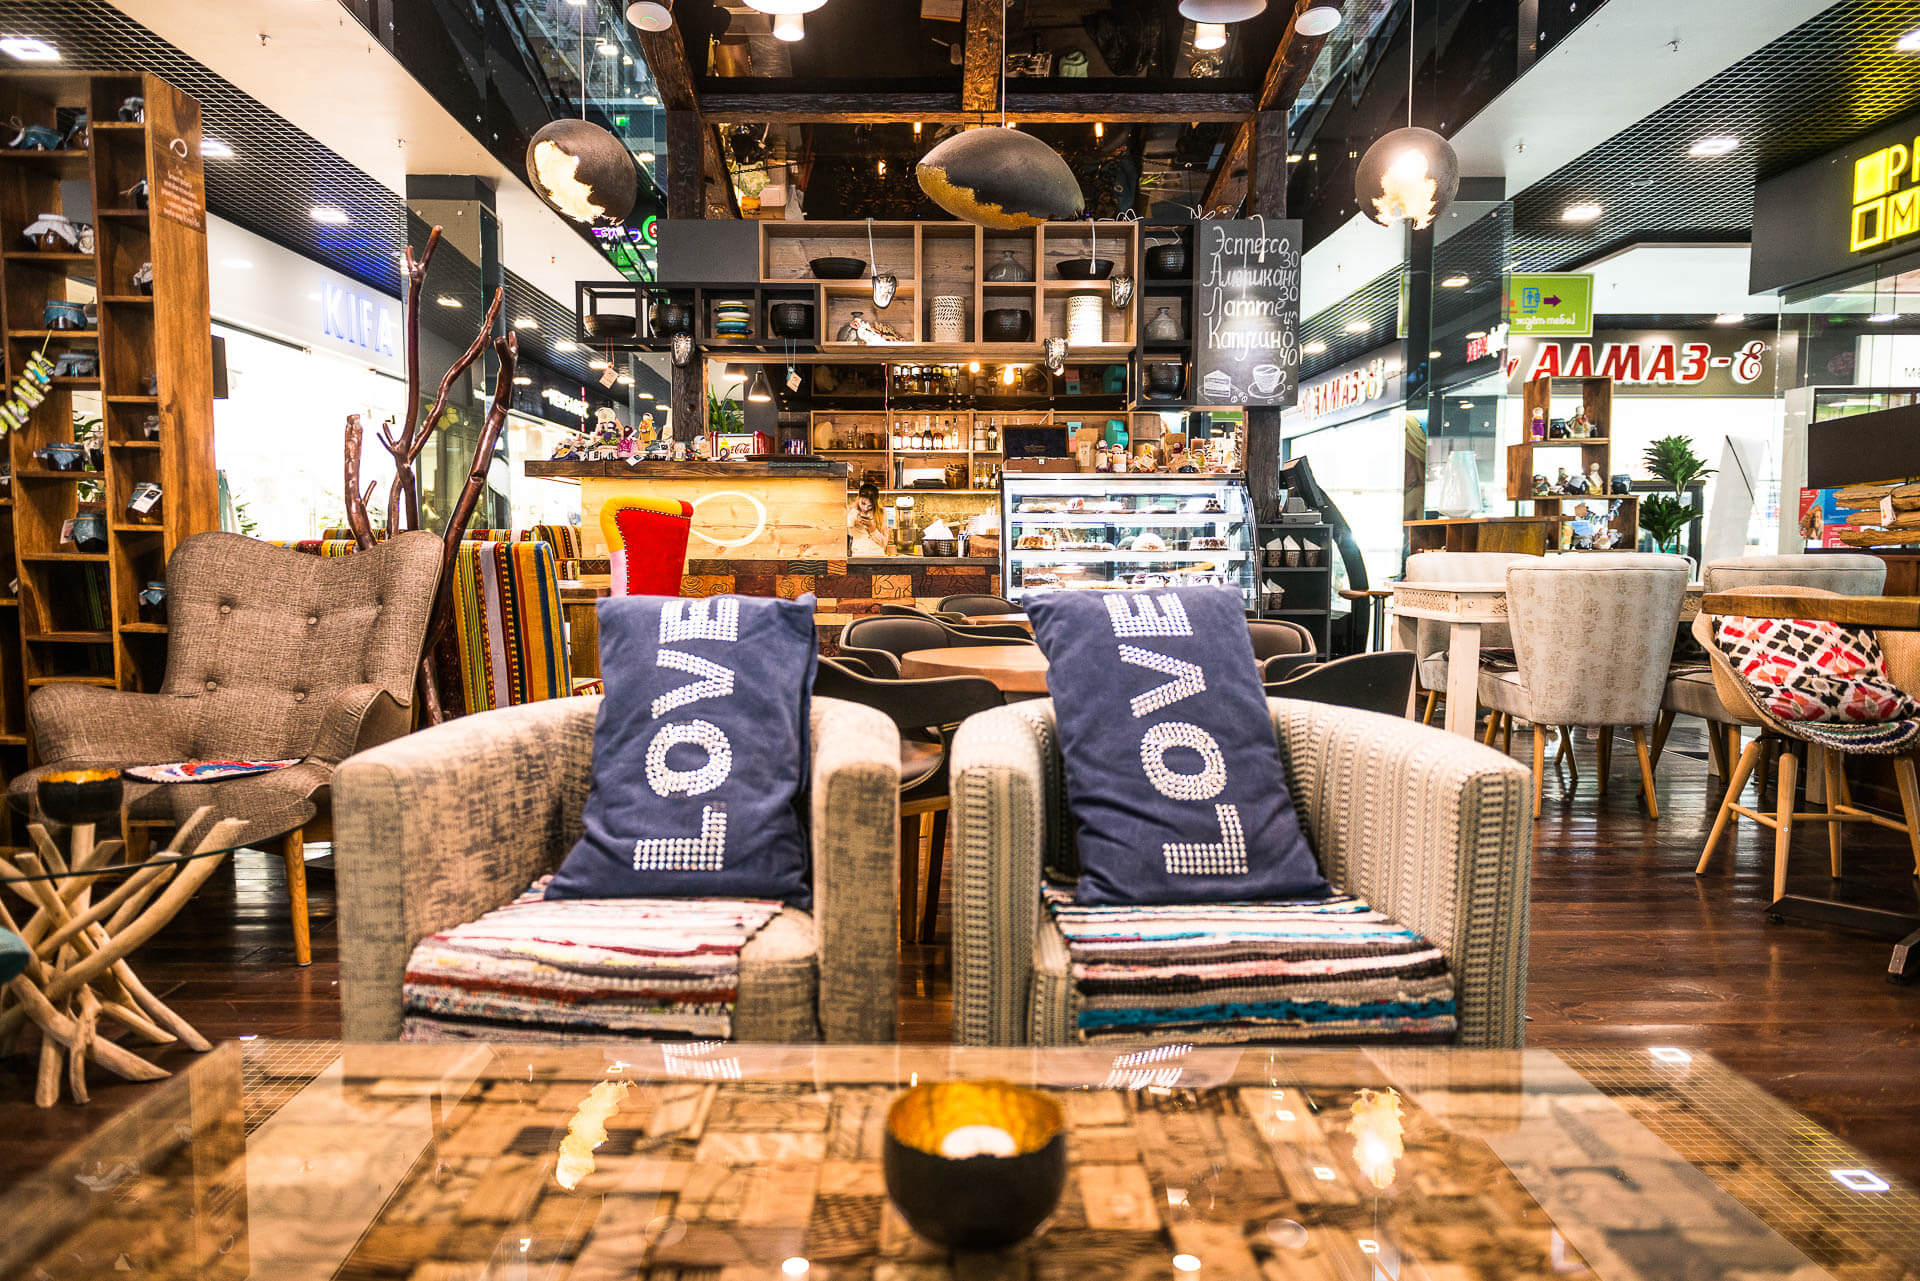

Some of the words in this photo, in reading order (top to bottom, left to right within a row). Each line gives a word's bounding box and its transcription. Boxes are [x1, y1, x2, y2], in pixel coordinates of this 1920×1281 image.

[1210, 226, 1290, 268] Эспрессо
[1280, 250, 1299, 269] 30
[1203, 286, 1286, 317] Латте
[1278, 286, 1299, 302] 30
[320, 278, 393, 356] KIFA
[1208, 316, 1294, 362] Капучино
[1279, 347, 1298, 367] 40
[633, 598, 740, 872] LOVE
[1103, 592, 1249, 875] LOVE
